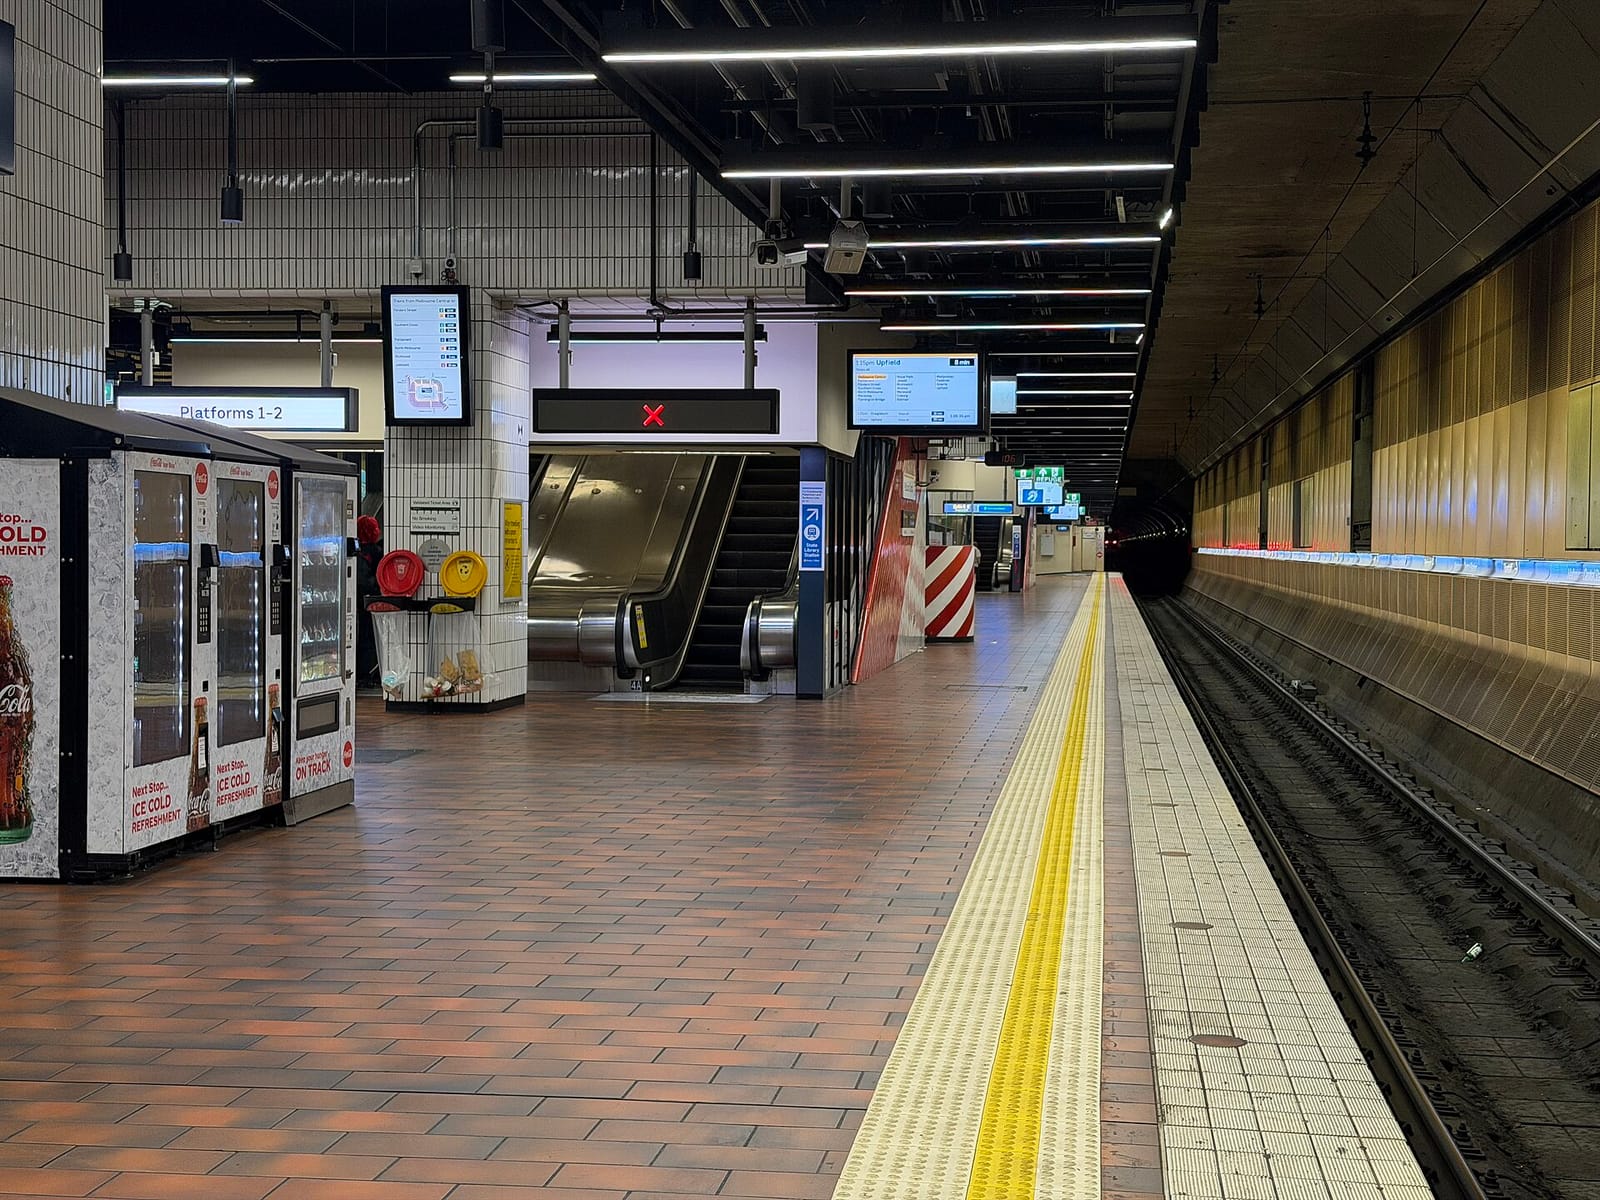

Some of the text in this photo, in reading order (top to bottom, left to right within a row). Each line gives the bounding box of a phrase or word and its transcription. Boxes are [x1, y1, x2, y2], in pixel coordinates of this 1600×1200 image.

[876, 359, 901, 367] Upfield
[180, 406, 283, 420] Platforms 1-2
[217, 762, 230, 775] Next
[296, 759, 331, 780] ON TRACK
[132, 783, 147, 798] Next
[217, 771, 250, 793] ICE COLD
[132, 794, 171, 818] ICE COLD
[216, 785, 258, 807] REFRESHMENT
[132, 809, 181, 835] REFRESHMENT
